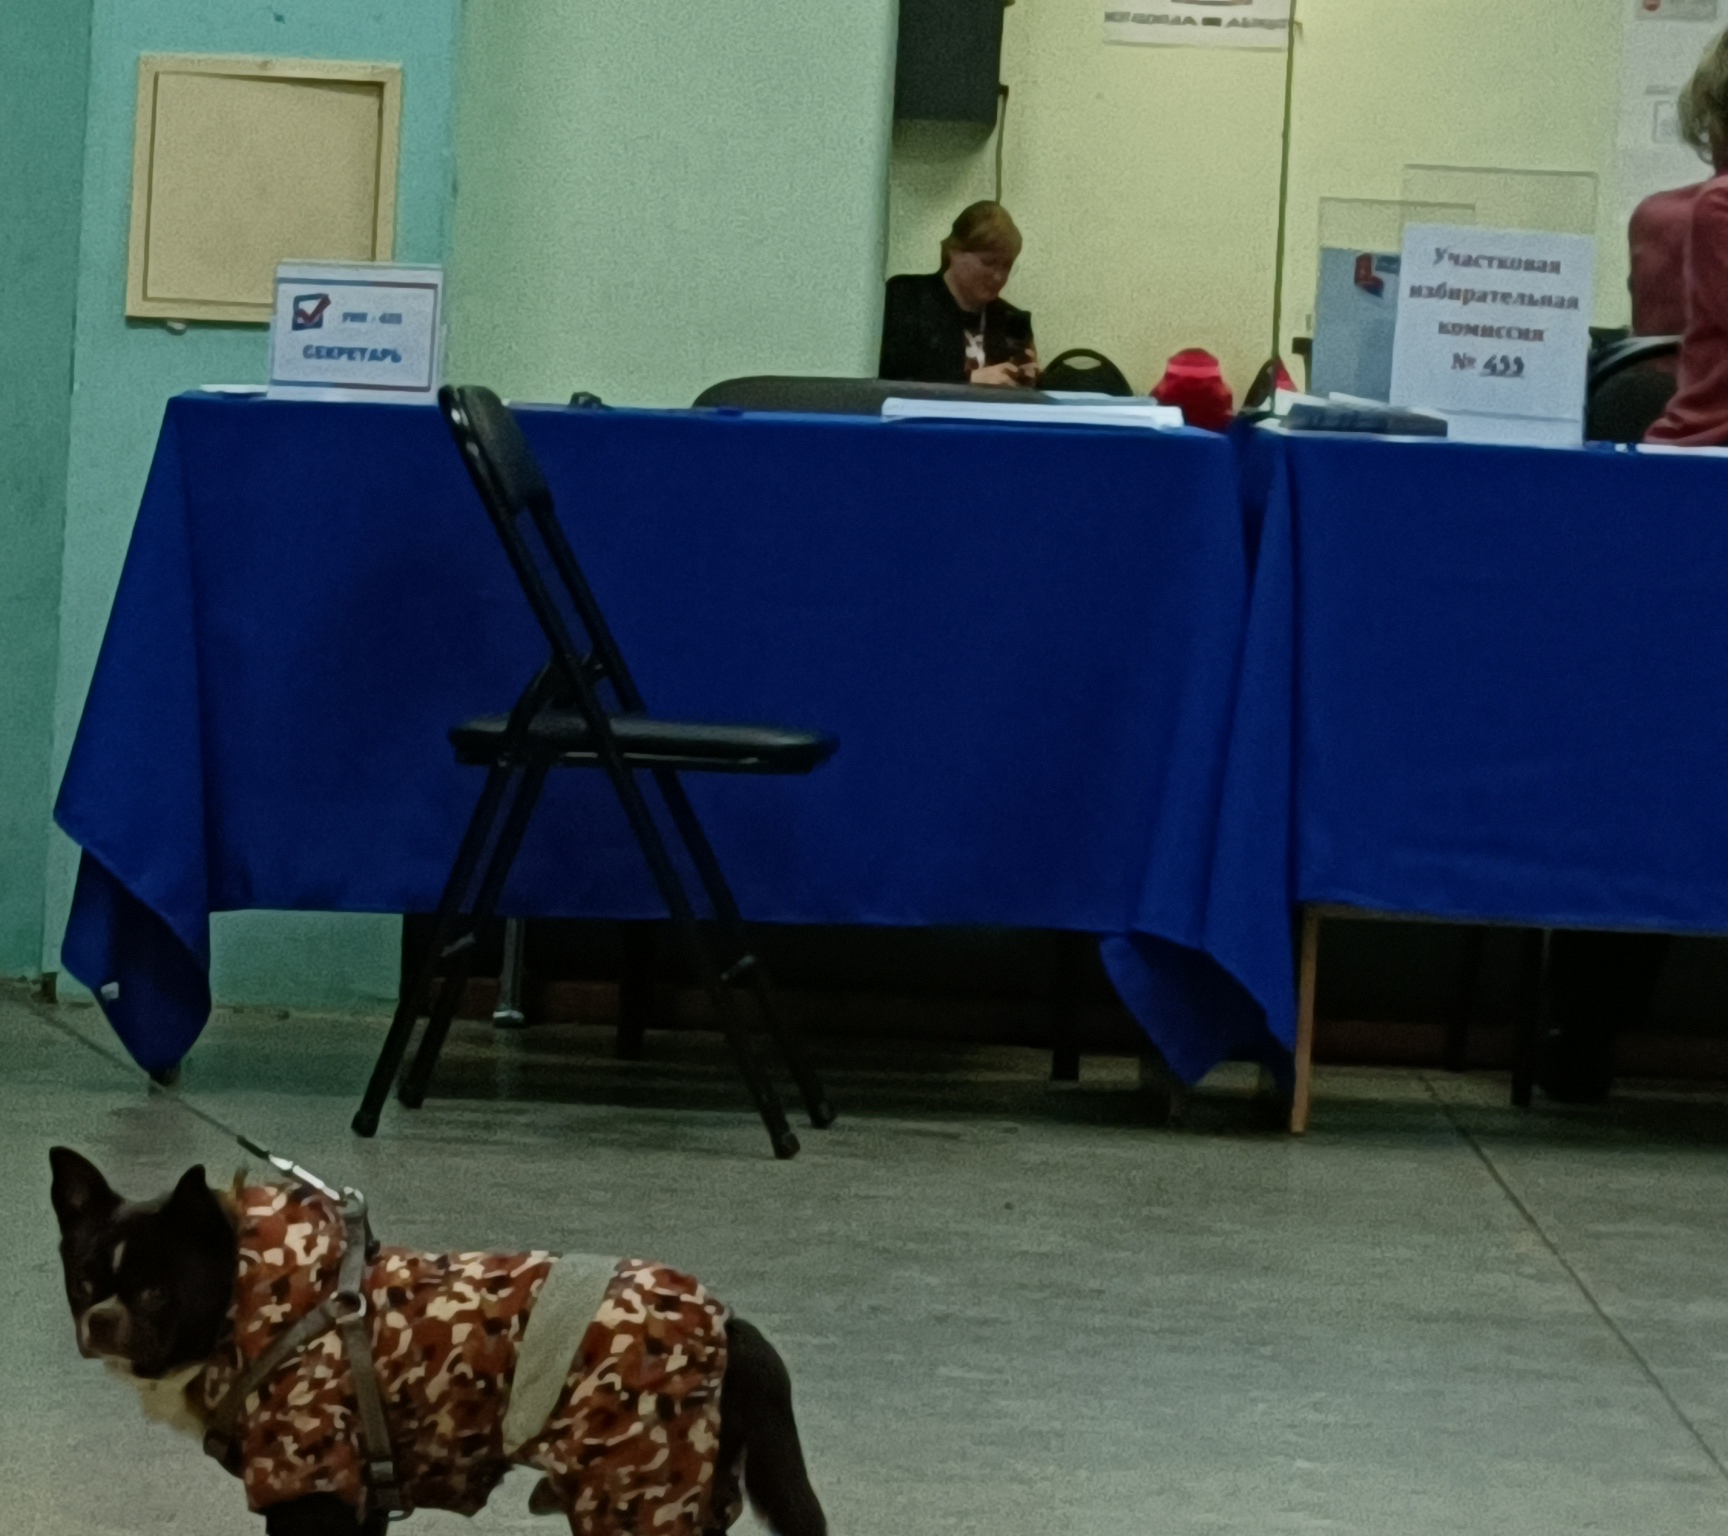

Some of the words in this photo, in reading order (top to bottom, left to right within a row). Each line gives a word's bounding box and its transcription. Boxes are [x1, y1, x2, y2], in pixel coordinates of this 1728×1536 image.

[1433, 247, 1561, 275] Участковая
[1409, 281, 1579, 310] избирательная
[1438, 321, 1544, 342] комиссия
